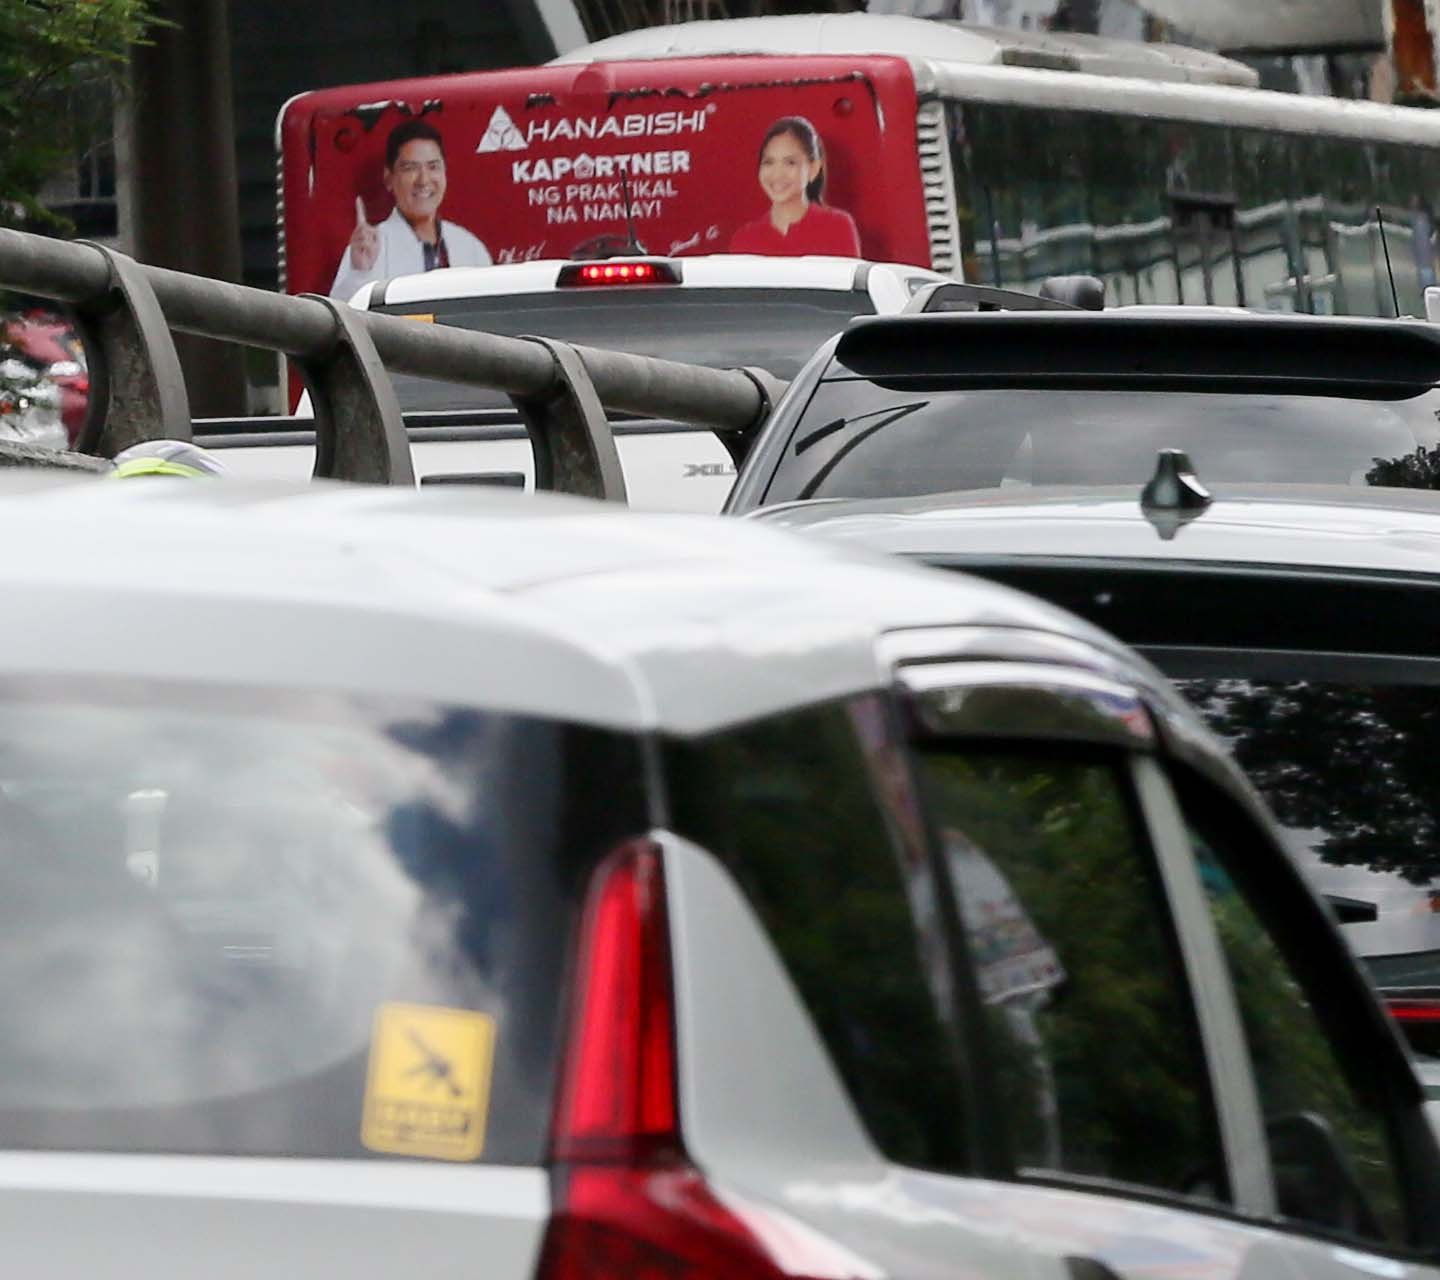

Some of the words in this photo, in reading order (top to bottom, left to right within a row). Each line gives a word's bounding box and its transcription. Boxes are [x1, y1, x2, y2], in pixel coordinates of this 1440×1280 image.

[527, 109, 707, 143] HANABISHI
[528, 185, 561, 207] NG
[566, 180, 678, 203] PRAKTIKAL
[545, 205, 578, 225] NA
[583, 199, 663, 223] NANAY!
